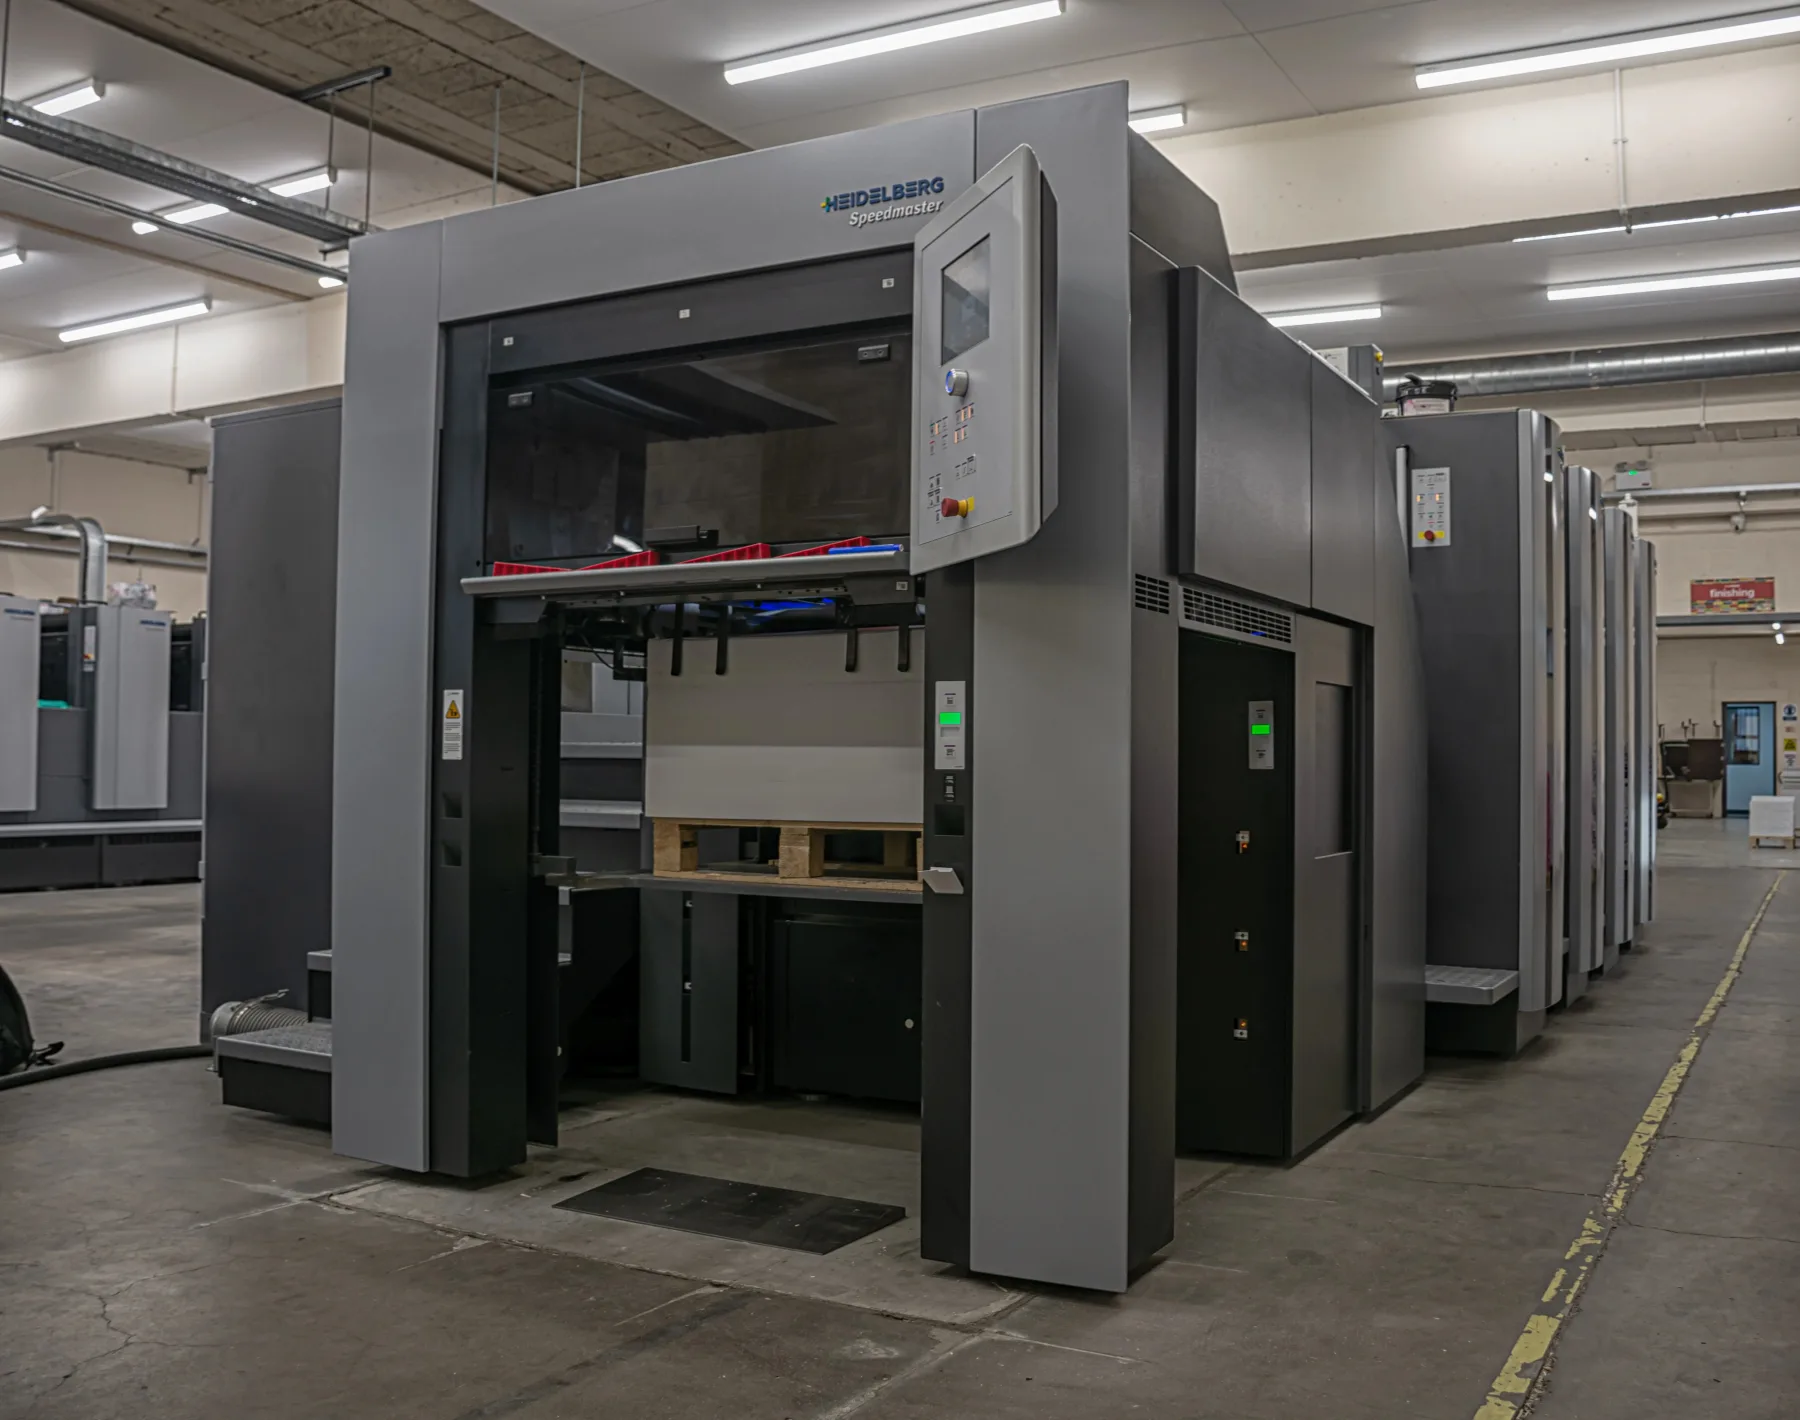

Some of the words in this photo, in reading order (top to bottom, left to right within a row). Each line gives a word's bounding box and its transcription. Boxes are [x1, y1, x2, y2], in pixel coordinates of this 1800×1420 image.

[821, 176, 944, 212] HEIDELBERG
[849, 200, 943, 228] Speedmaster
[1709, 587, 1755, 599] finishing
